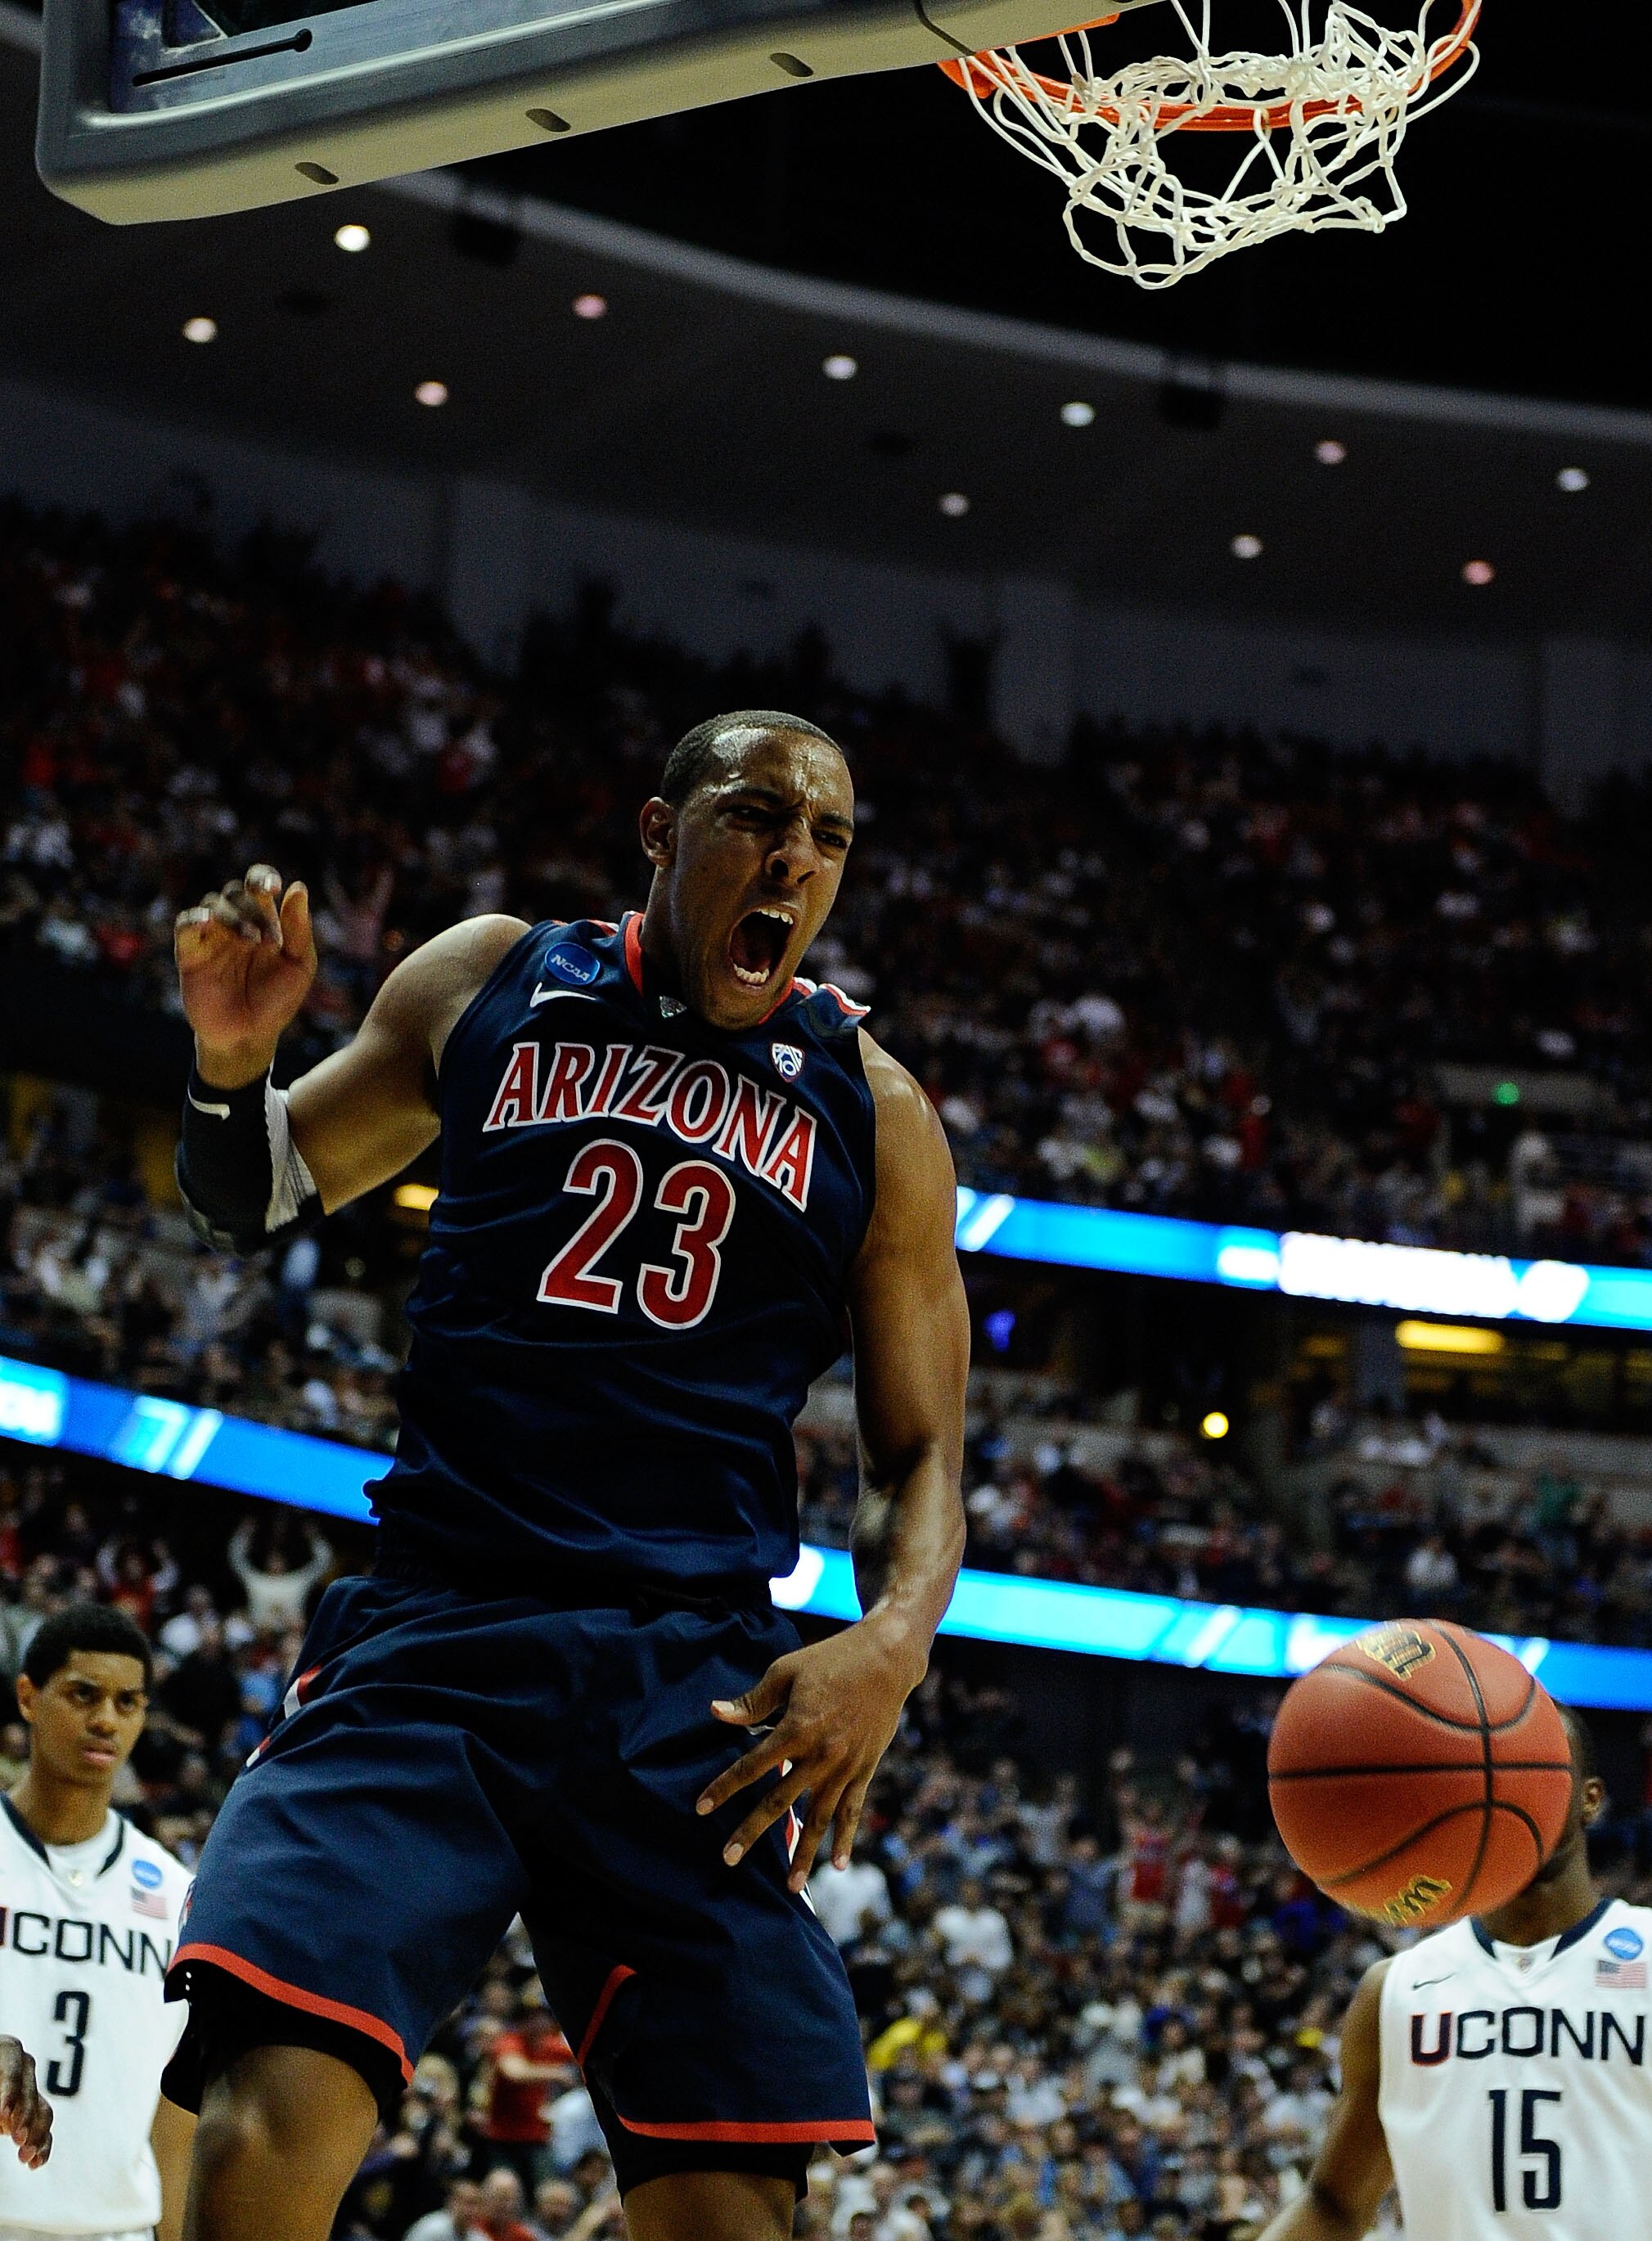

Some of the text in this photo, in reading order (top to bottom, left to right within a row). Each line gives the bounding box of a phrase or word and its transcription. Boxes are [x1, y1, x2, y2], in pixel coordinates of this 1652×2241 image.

[551, 954, 590, 981] NCAA
[483, 1042, 817, 1213] ARIZONA
[537, 1139, 736, 1330] 23
[0, 1906, 171, 1981] CONN
[47, 1991, 89, 2096] 3
[1411, 2006, 1645, 2067] UCONN
[1488, 2089, 1562, 2212] 15
